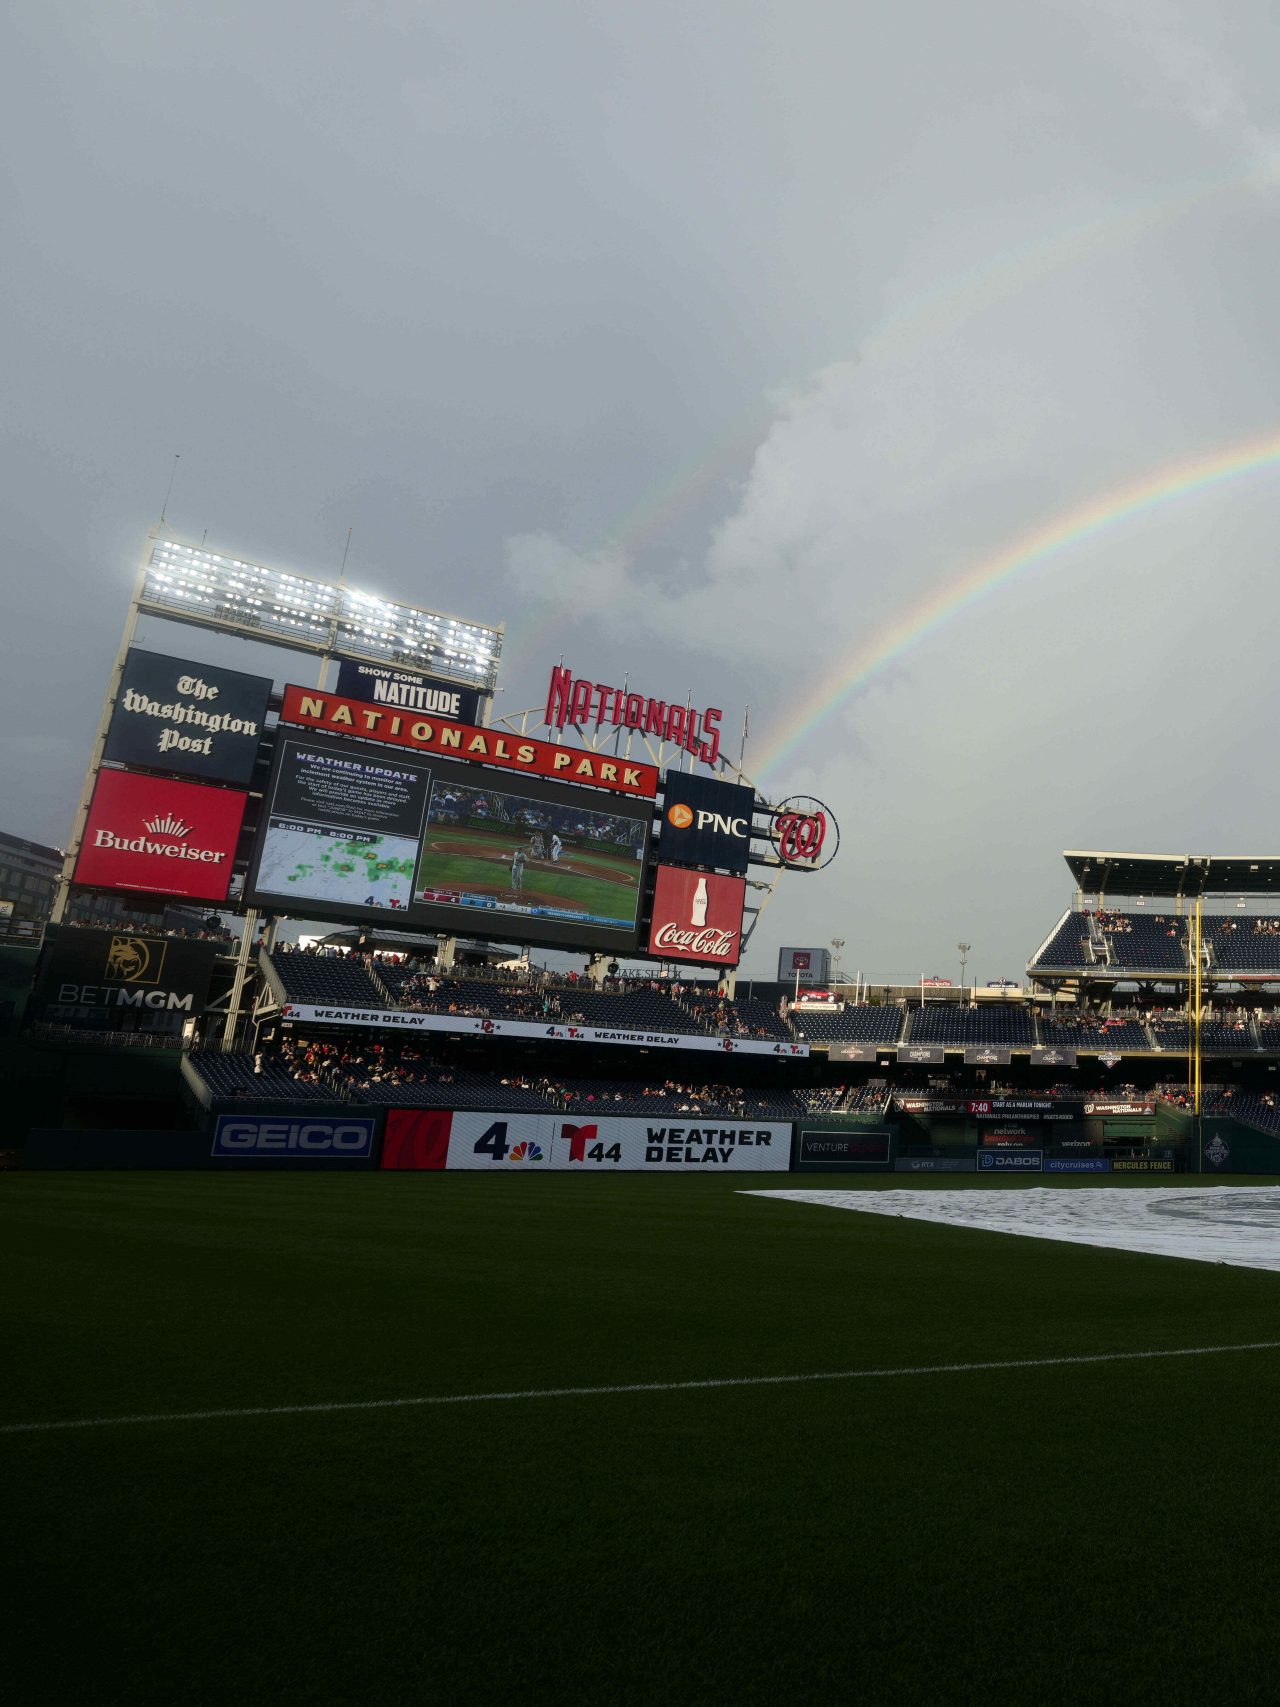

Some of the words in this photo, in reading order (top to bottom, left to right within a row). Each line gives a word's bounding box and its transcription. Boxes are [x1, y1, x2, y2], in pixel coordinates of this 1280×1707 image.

[176, 675, 220, 701] The
[358, 666, 390, 682] SHOW
[393, 671, 423, 686] SOME
[374, 679, 461, 715] NATITUDE
[122, 688, 258, 738] Washington
[544, 666, 722, 764] NATIONALS
[156, 728, 214, 756] Post
[300, 696, 536, 764] NATIONALS
[554, 753, 644, 787] PARK
[296, 752, 362, 771] WEATHER
[366, 766, 417, 782] UPDATE
[329, 831, 353, 840] 8:00
[697, 810, 748, 838] PNC
[93, 830, 226, 864] Budweiser
[365, 896, 374, 906] 4
[655, 922, 737, 957] Coca-Cola
[58, 984, 194, 1011] BETMGM
[314, 1010, 379, 1022] WEATHER
[382, 1015, 425, 1026] DELAY
[546, 1026, 555, 1036] 4
[594, 1032, 645, 1043] WEATHER
[646, 1034, 679, 1044] DELAY
[773, 1044, 781, 1054] 4
[971, 1102, 988, 1112] 7:40
[220, 1124, 368, 1150] GEICO
[473, 1122, 510, 1160] 4
[646, 1127, 772, 1146] WEATHER
[806, 1142, 849, 1152] VENTURE
[644, 1146, 734, 1163] DELAY
[996, 1157, 1040, 1166] DABOS
[1113, 1161, 1148, 1170] HERCULES
[1150, 1161, 1172, 1170] FENCE
